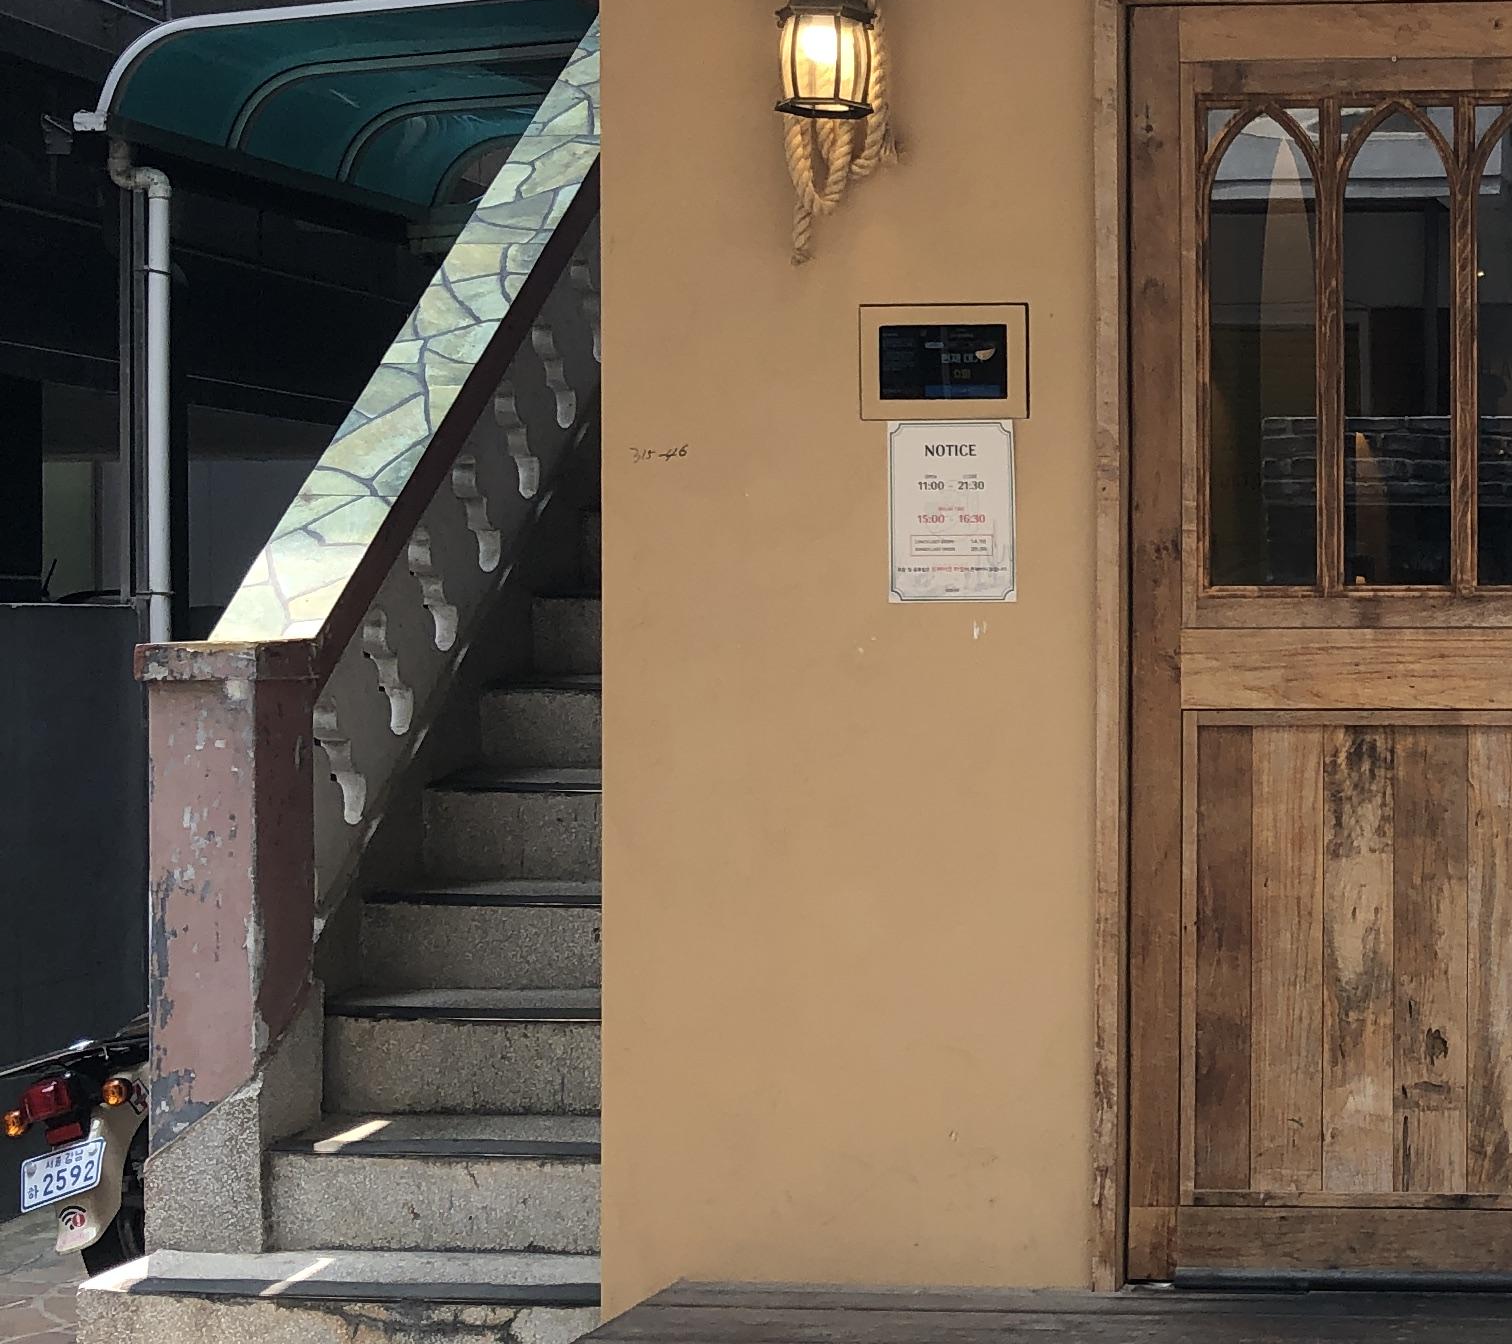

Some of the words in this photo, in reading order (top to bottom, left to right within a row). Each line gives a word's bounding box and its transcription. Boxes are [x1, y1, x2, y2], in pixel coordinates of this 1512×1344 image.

[924, 443, 977, 457] NOTICE
[918, 481, 945, 490] 11:00
[957, 481, 985, 490] 21:30
[917, 514, 945, 524] 15:00
[959, 514, 986, 524] 16:30
[42, 1160, 95, 1197] 2592
